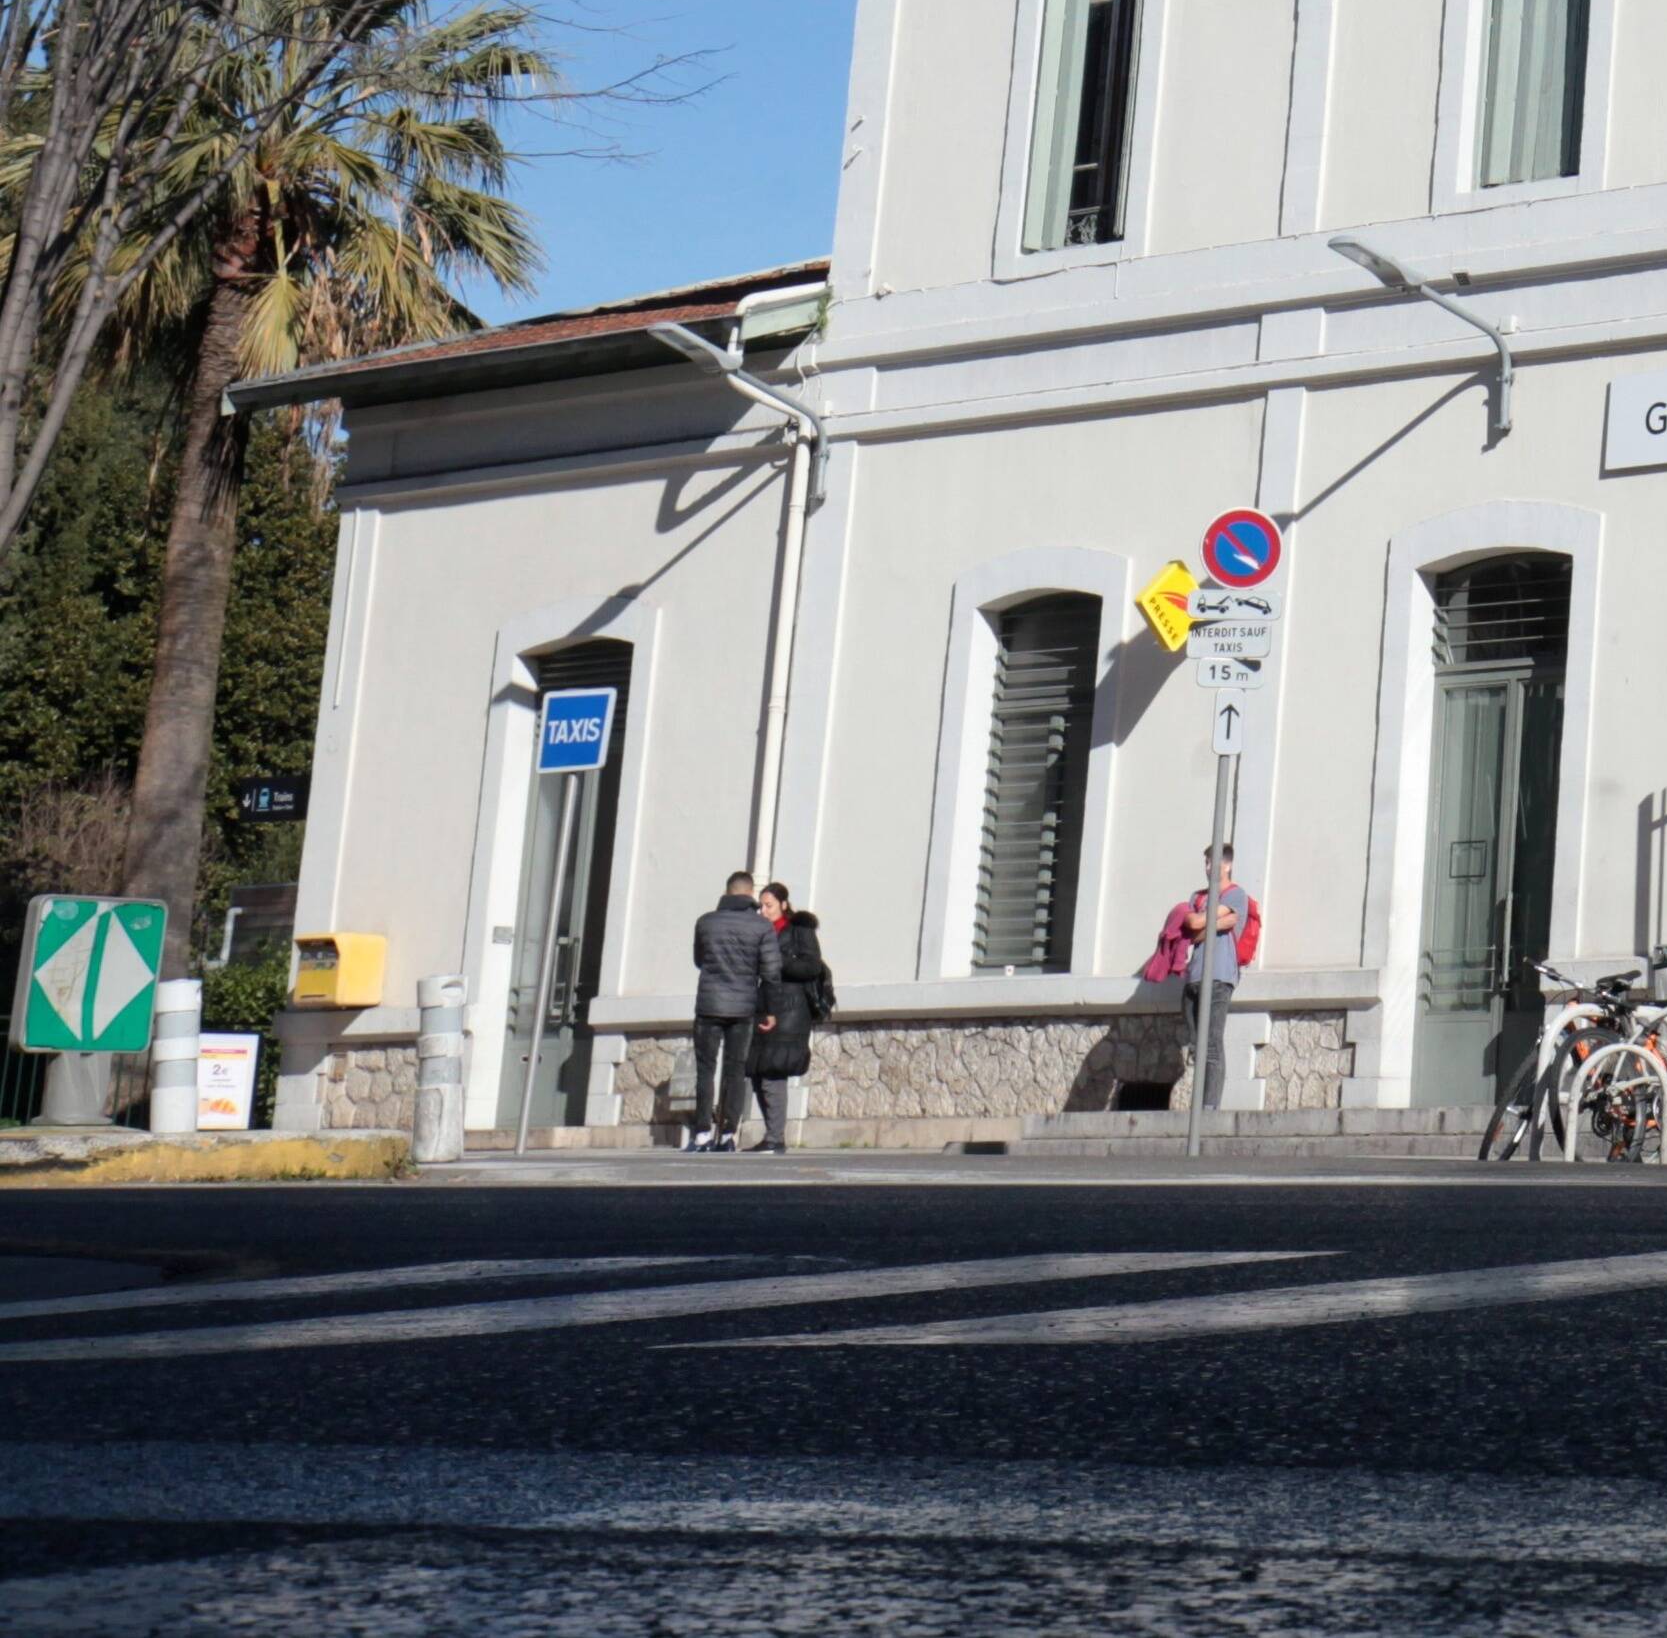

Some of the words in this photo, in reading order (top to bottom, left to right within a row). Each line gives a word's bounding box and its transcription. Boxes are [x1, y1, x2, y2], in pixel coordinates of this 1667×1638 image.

[1149, 596, 1179, 642] PRESSE
[1191, 626, 1237, 639] INTERDIT
[1239, 626, 1267, 638] SAUF
[1213, 642, 1243, 653] TAXIS
[1209, 664, 1231, 681] 15
[1235, 671, 1249, 681] m
[549, 718, 601, 745] TAXIS
